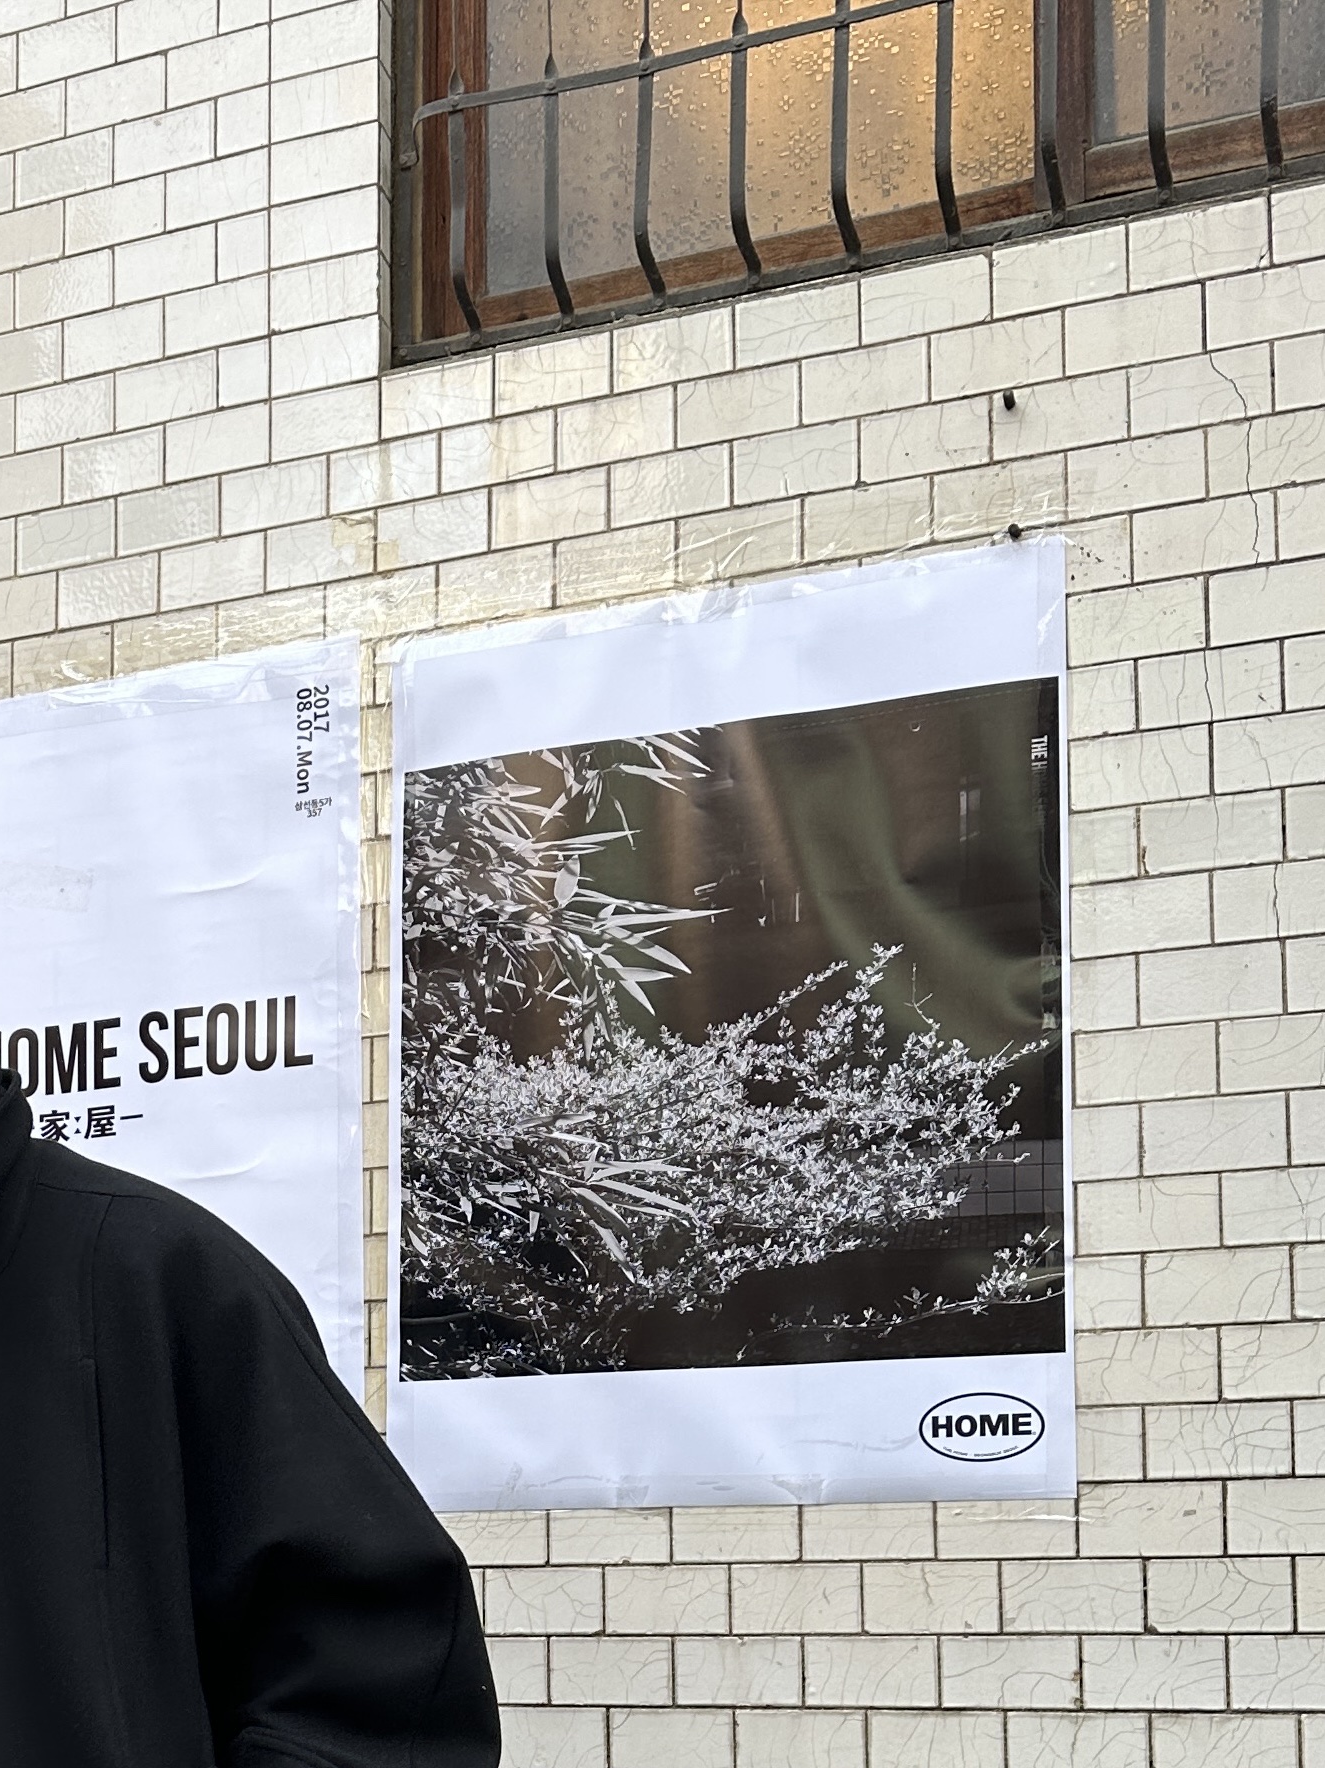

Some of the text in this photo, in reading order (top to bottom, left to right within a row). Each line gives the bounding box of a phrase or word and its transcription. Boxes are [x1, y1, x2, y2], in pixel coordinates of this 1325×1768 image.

[314, 684, 330, 732] 2017
[1031, 735, 1048, 760] THE
[138, 995, 314, 1084] SEOUL
[931, 1413, 1032, 1438] HOME
